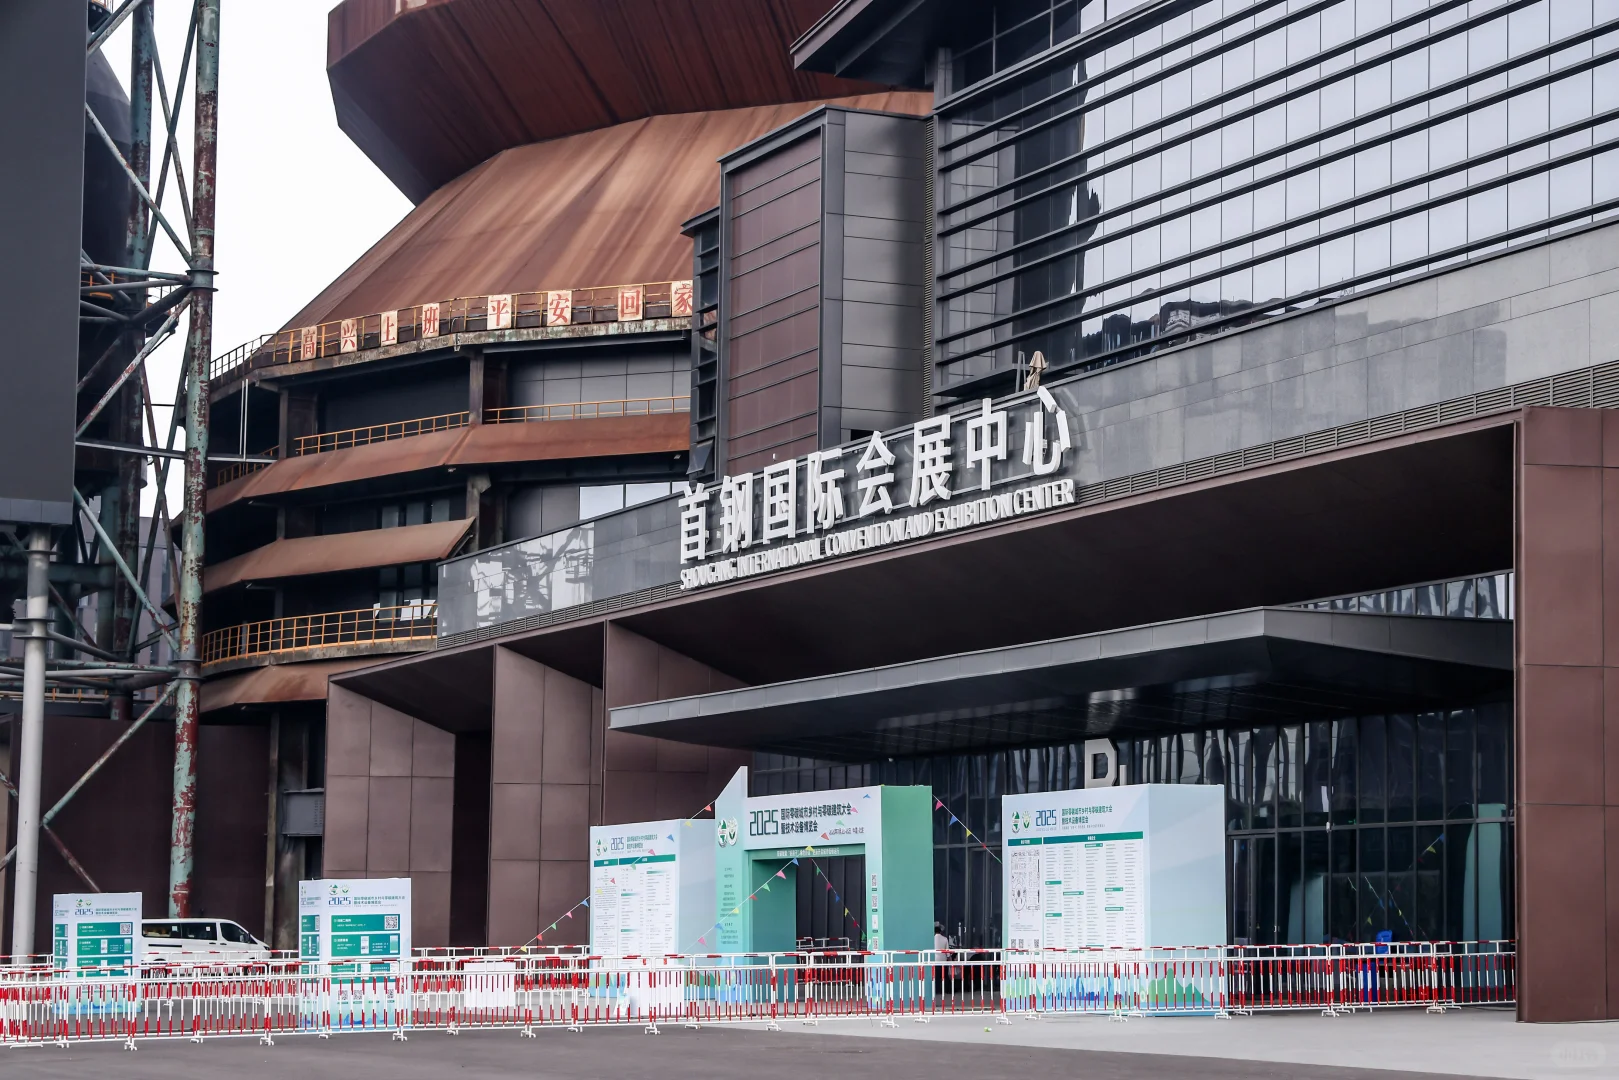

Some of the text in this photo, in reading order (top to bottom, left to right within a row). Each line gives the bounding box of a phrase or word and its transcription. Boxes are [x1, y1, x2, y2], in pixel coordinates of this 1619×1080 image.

[301, 281, 693, 359] 高兴上班平安回家
[678, 386, 1072, 564] 首钢国际会展中心
[680, 478, 1076, 590] SHOUGANG INTERNATIONAL CONVENTION AND EXHIBITION CENTER
[749, 809, 779, 837] 2025
[1035, 809, 1057, 827] 2025
[610, 836, 625, 851] 2025
[75, 908, 94, 916] 2025
[328, 896, 351, 906] 2025
